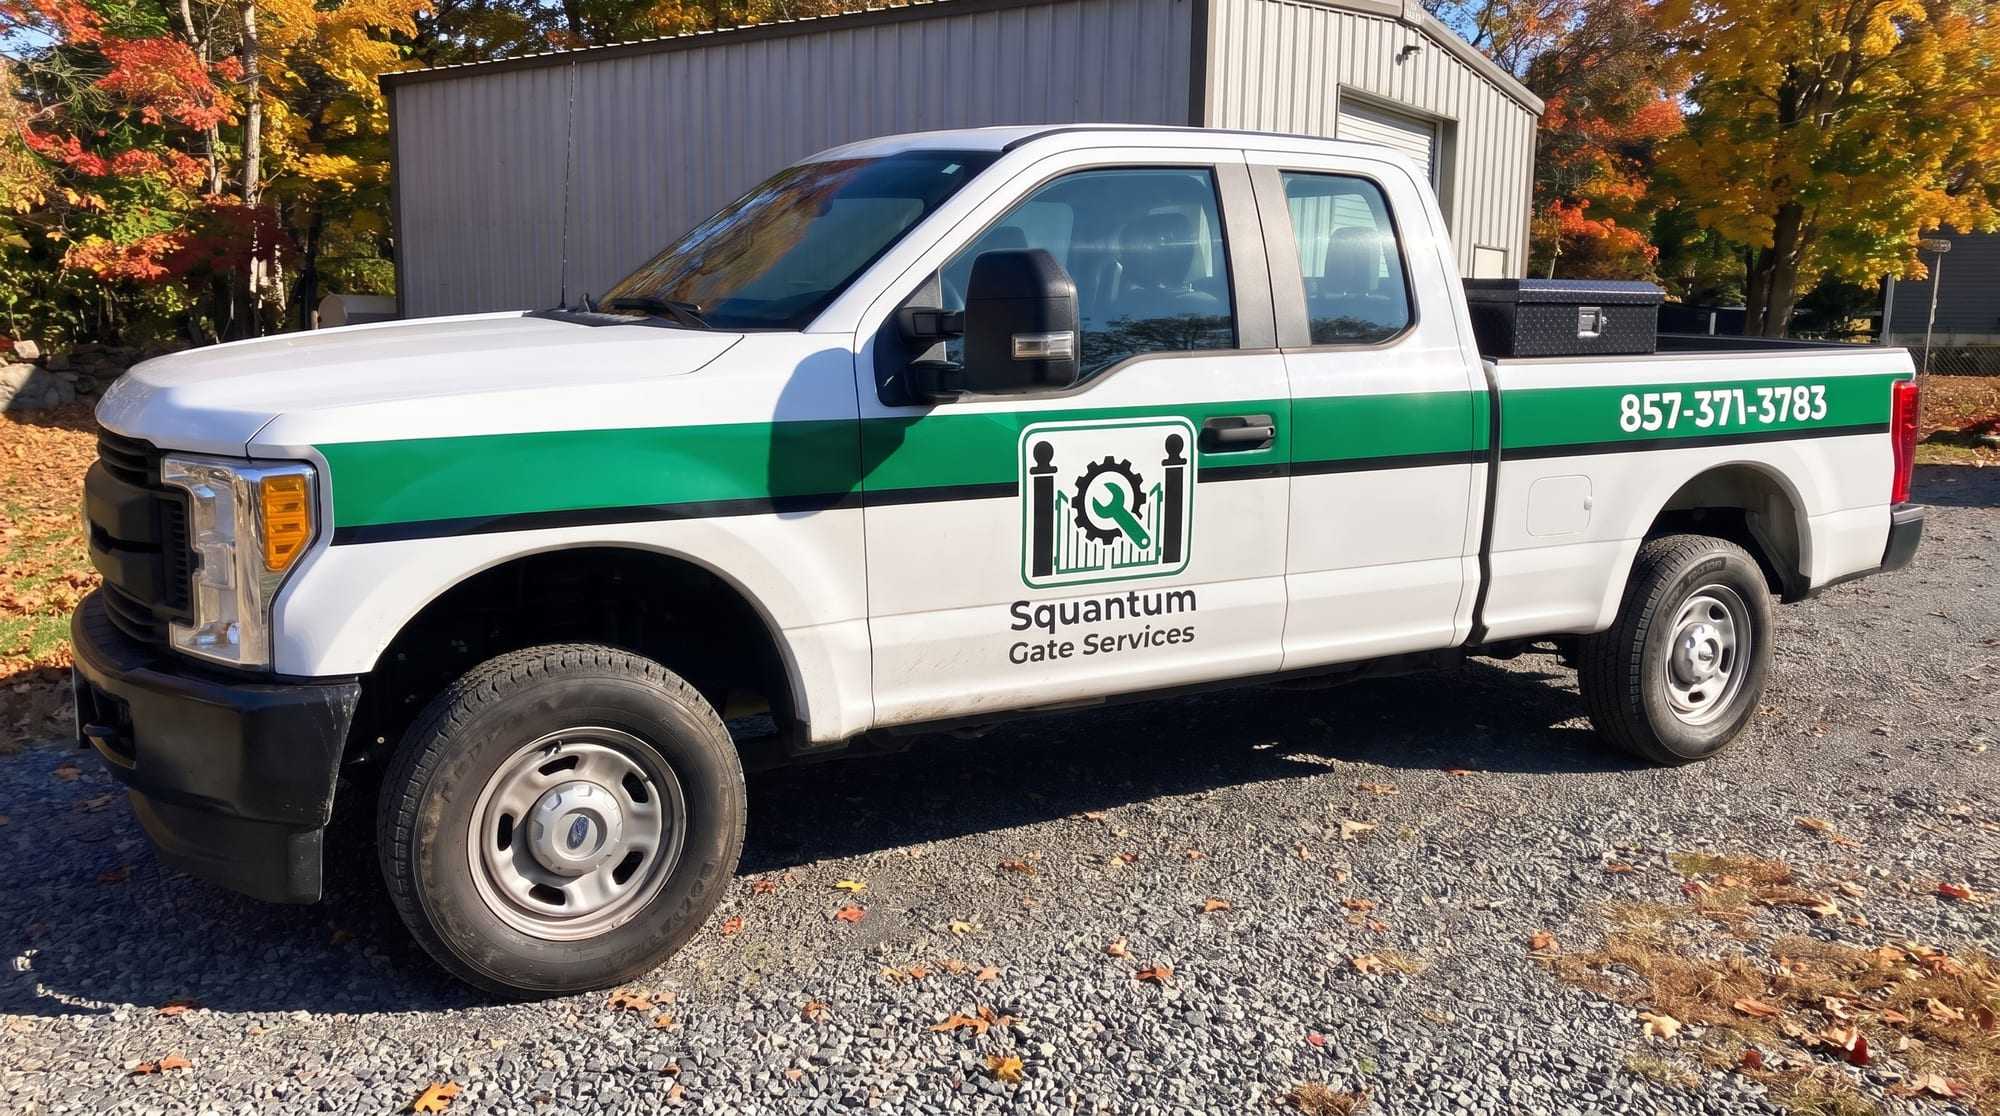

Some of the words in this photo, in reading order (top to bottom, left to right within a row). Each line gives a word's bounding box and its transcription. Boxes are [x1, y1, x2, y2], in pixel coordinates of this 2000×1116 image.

[1619, 385, 1827, 433] 857-371-3783
[1010, 589, 1197, 635] Squantum
[1009, 639, 1075, 665] Gate
[1083, 624, 1195, 656] Services
